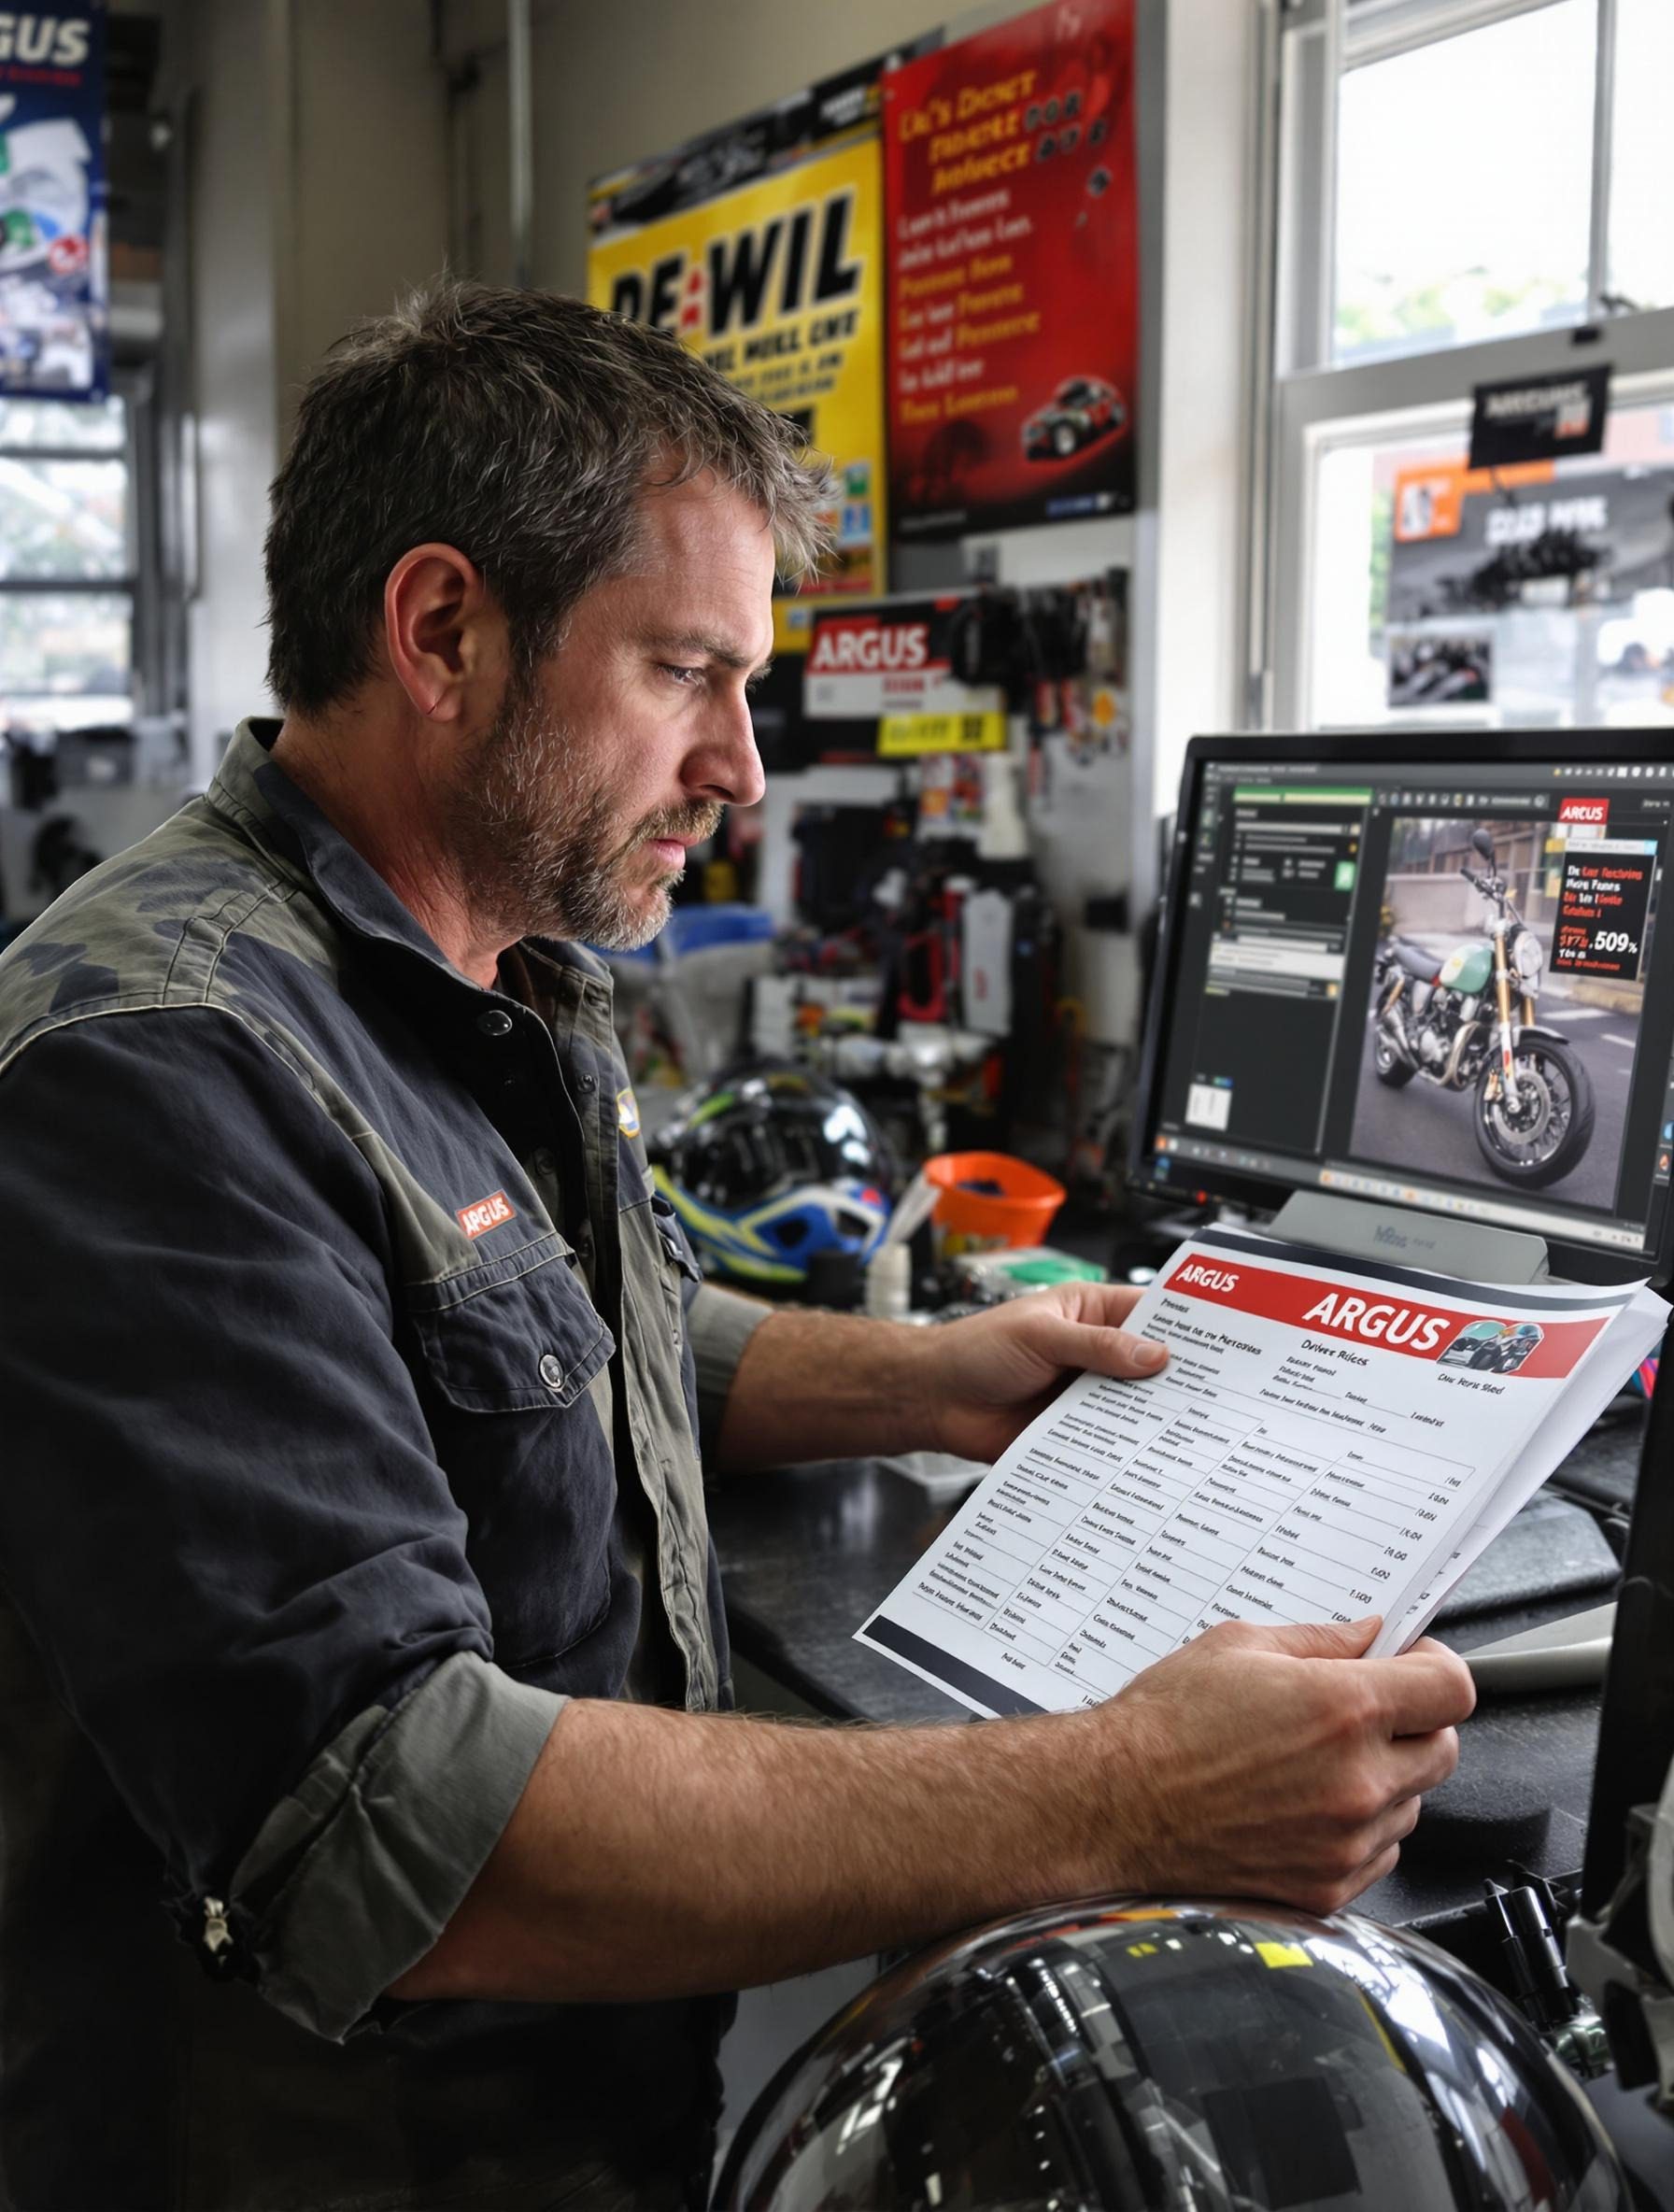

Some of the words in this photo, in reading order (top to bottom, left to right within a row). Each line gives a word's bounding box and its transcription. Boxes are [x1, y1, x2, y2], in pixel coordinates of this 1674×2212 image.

[815, 626, 929, 669] ARGUS
[1175, 1264, 1241, 1293] ARGUS
[1301, 1293, 1451, 1351] ARGUS
